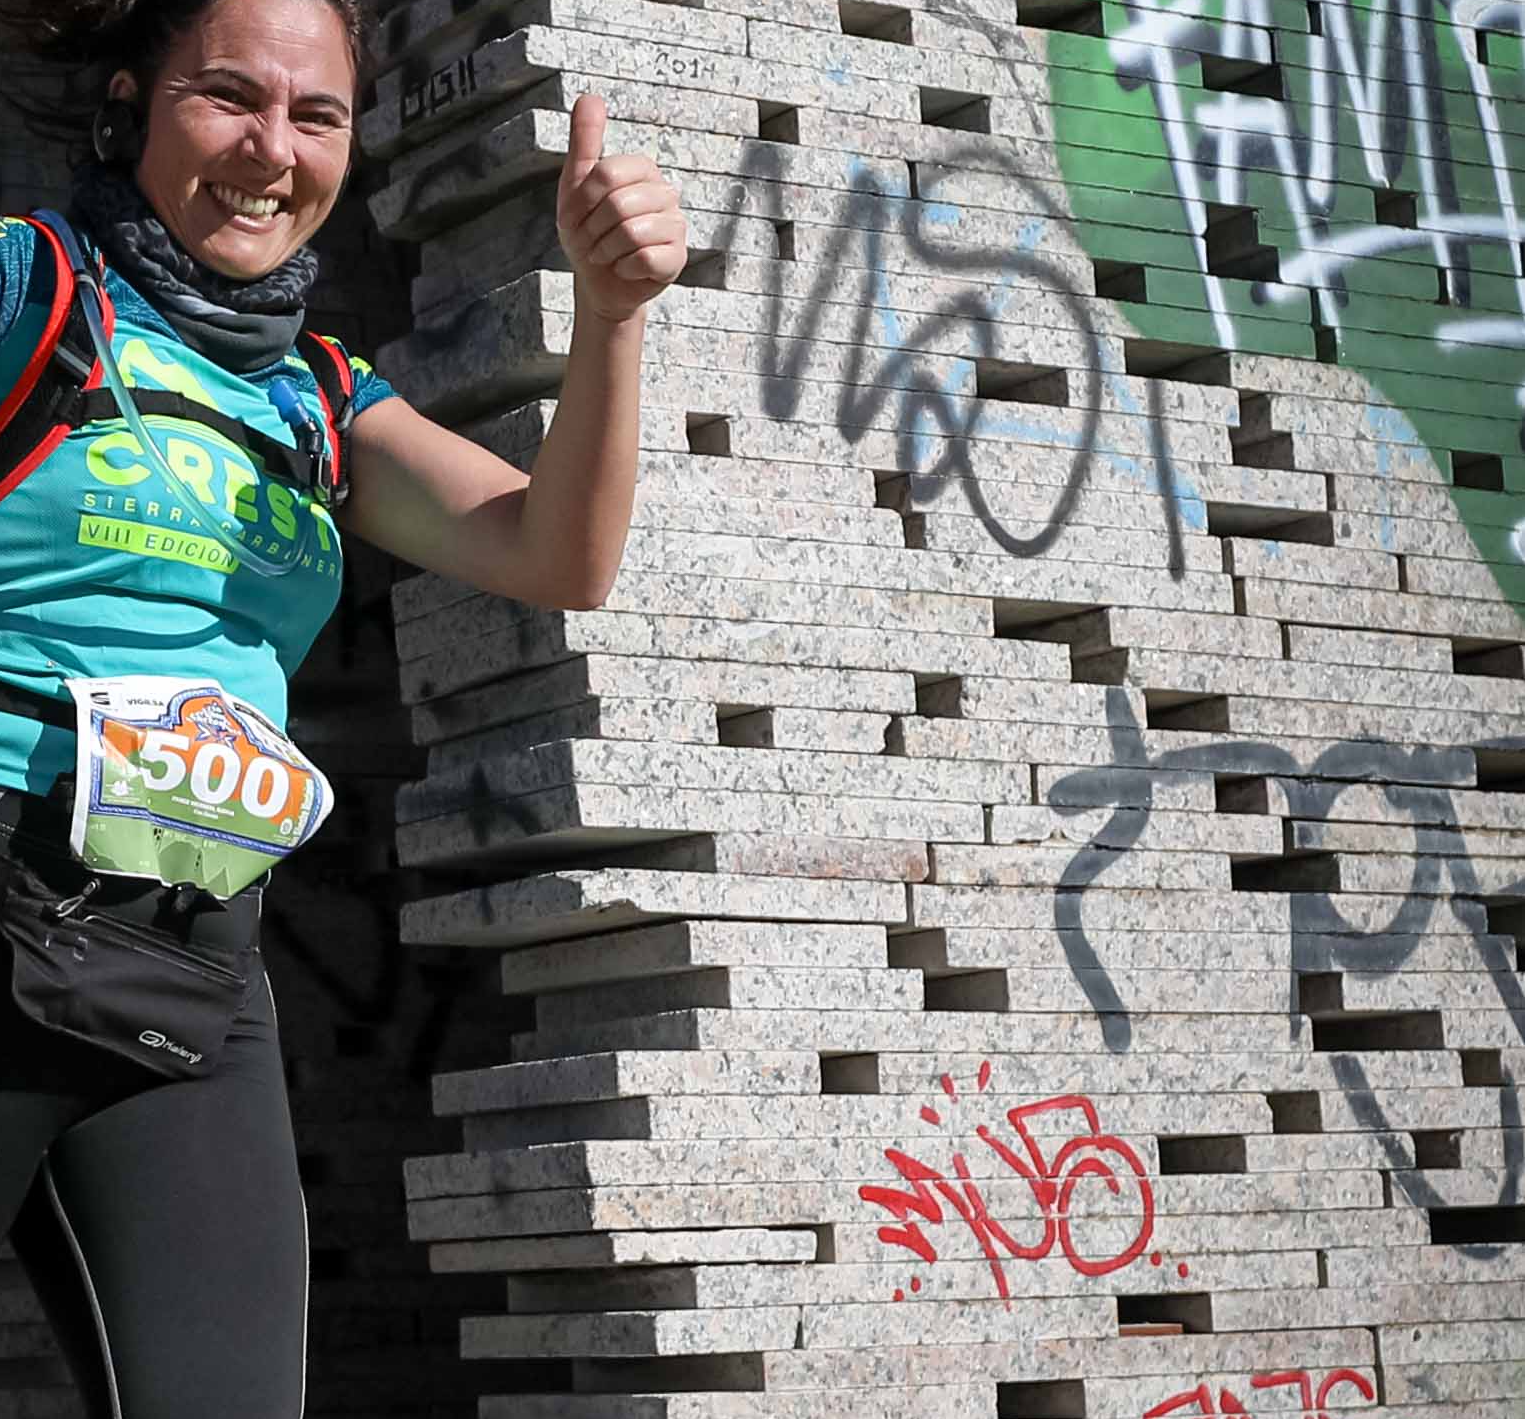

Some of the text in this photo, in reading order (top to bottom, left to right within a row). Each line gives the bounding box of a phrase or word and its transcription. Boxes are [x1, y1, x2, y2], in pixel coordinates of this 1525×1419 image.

[85, 431, 331, 552] CREST
[87, 522, 132, 545] VIII
[140, 728, 291, 819] 500
